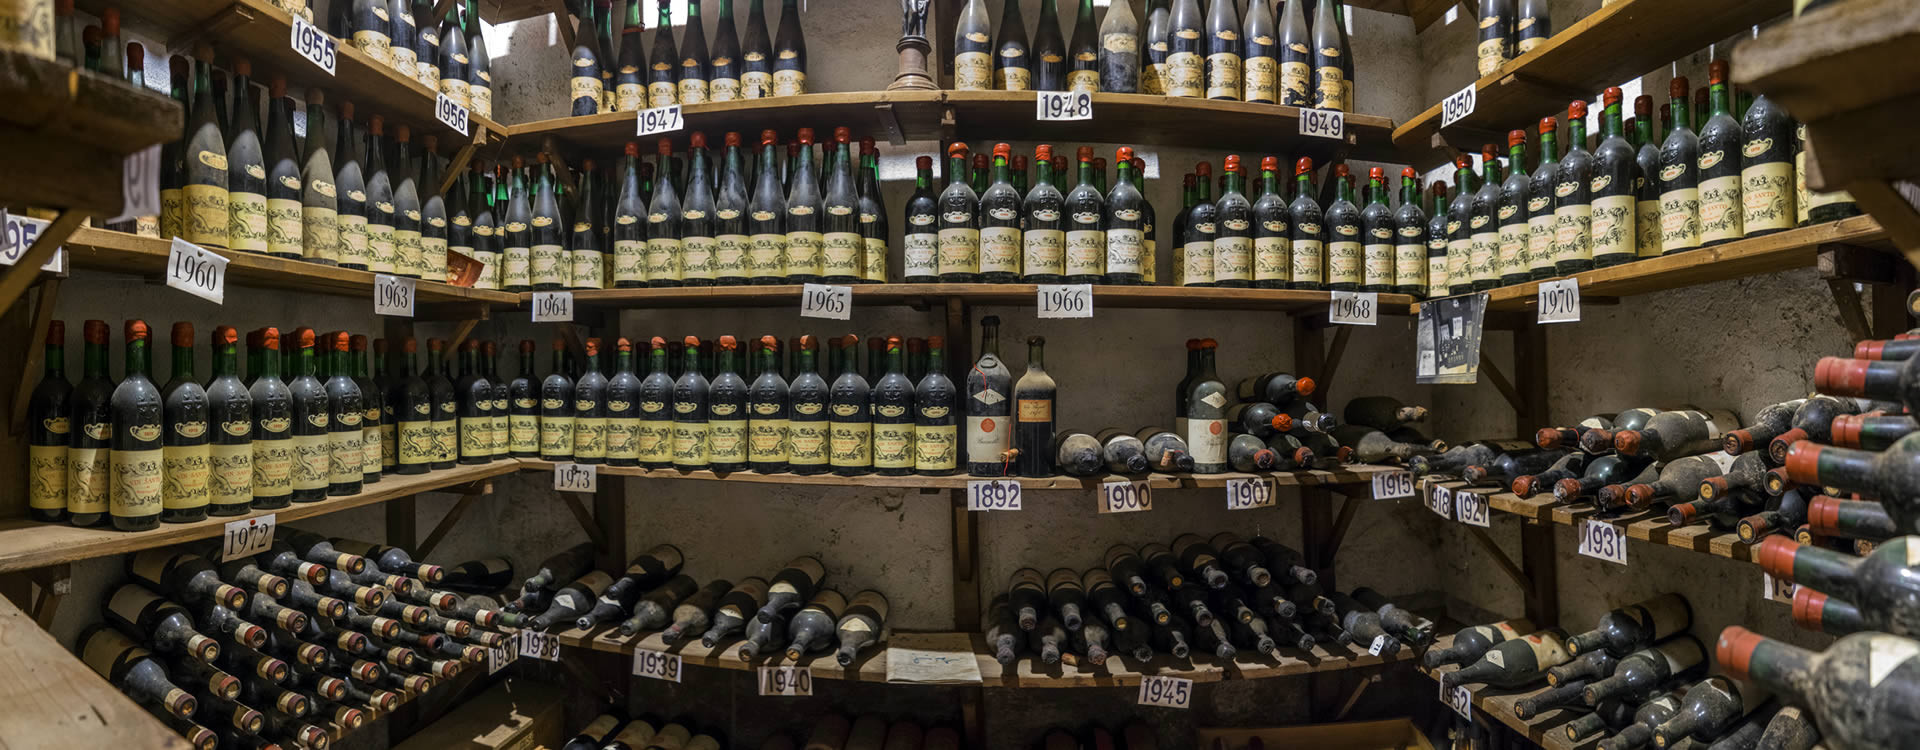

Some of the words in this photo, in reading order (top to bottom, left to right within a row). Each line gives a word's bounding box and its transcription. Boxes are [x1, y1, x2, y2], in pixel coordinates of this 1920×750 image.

[295, 21, 335, 69] 1955
[439, 95, 465, 131] 1956
[1043, 94, 1089, 118] 1948
[1445, 89, 1472, 124] 1950
[639, 108, 678, 133] 1947
[1302, 111, 1340, 136] 1949
[173, 250, 216, 291] 1960
[379, 284, 407, 308] 1963
[538, 298, 567, 316] 1964
[805, 290, 844, 313] 1965
[1043, 290, 1084, 312] 1966
[1335, 298, 1370, 319] 1968
[1541, 288, 1574, 315] 1970
[560, 469, 590, 488] 1973
[1381, 474, 1410, 496] 1915
[974, 483, 1019, 508] 1892
[1104, 483, 1150, 509] 1900
[1232, 481, 1273, 506] 1907
[1459, 494, 1487, 523] 1927
[227, 523, 268, 555] 1972
[1586, 522, 1621, 560] 1931
[493, 638, 517, 669] 1937
[526, 632, 557, 657] 1938
[640, 651, 678, 678] 1939
[768, 669, 810, 693] 1940
[1144, 678, 1188, 705] 1945
